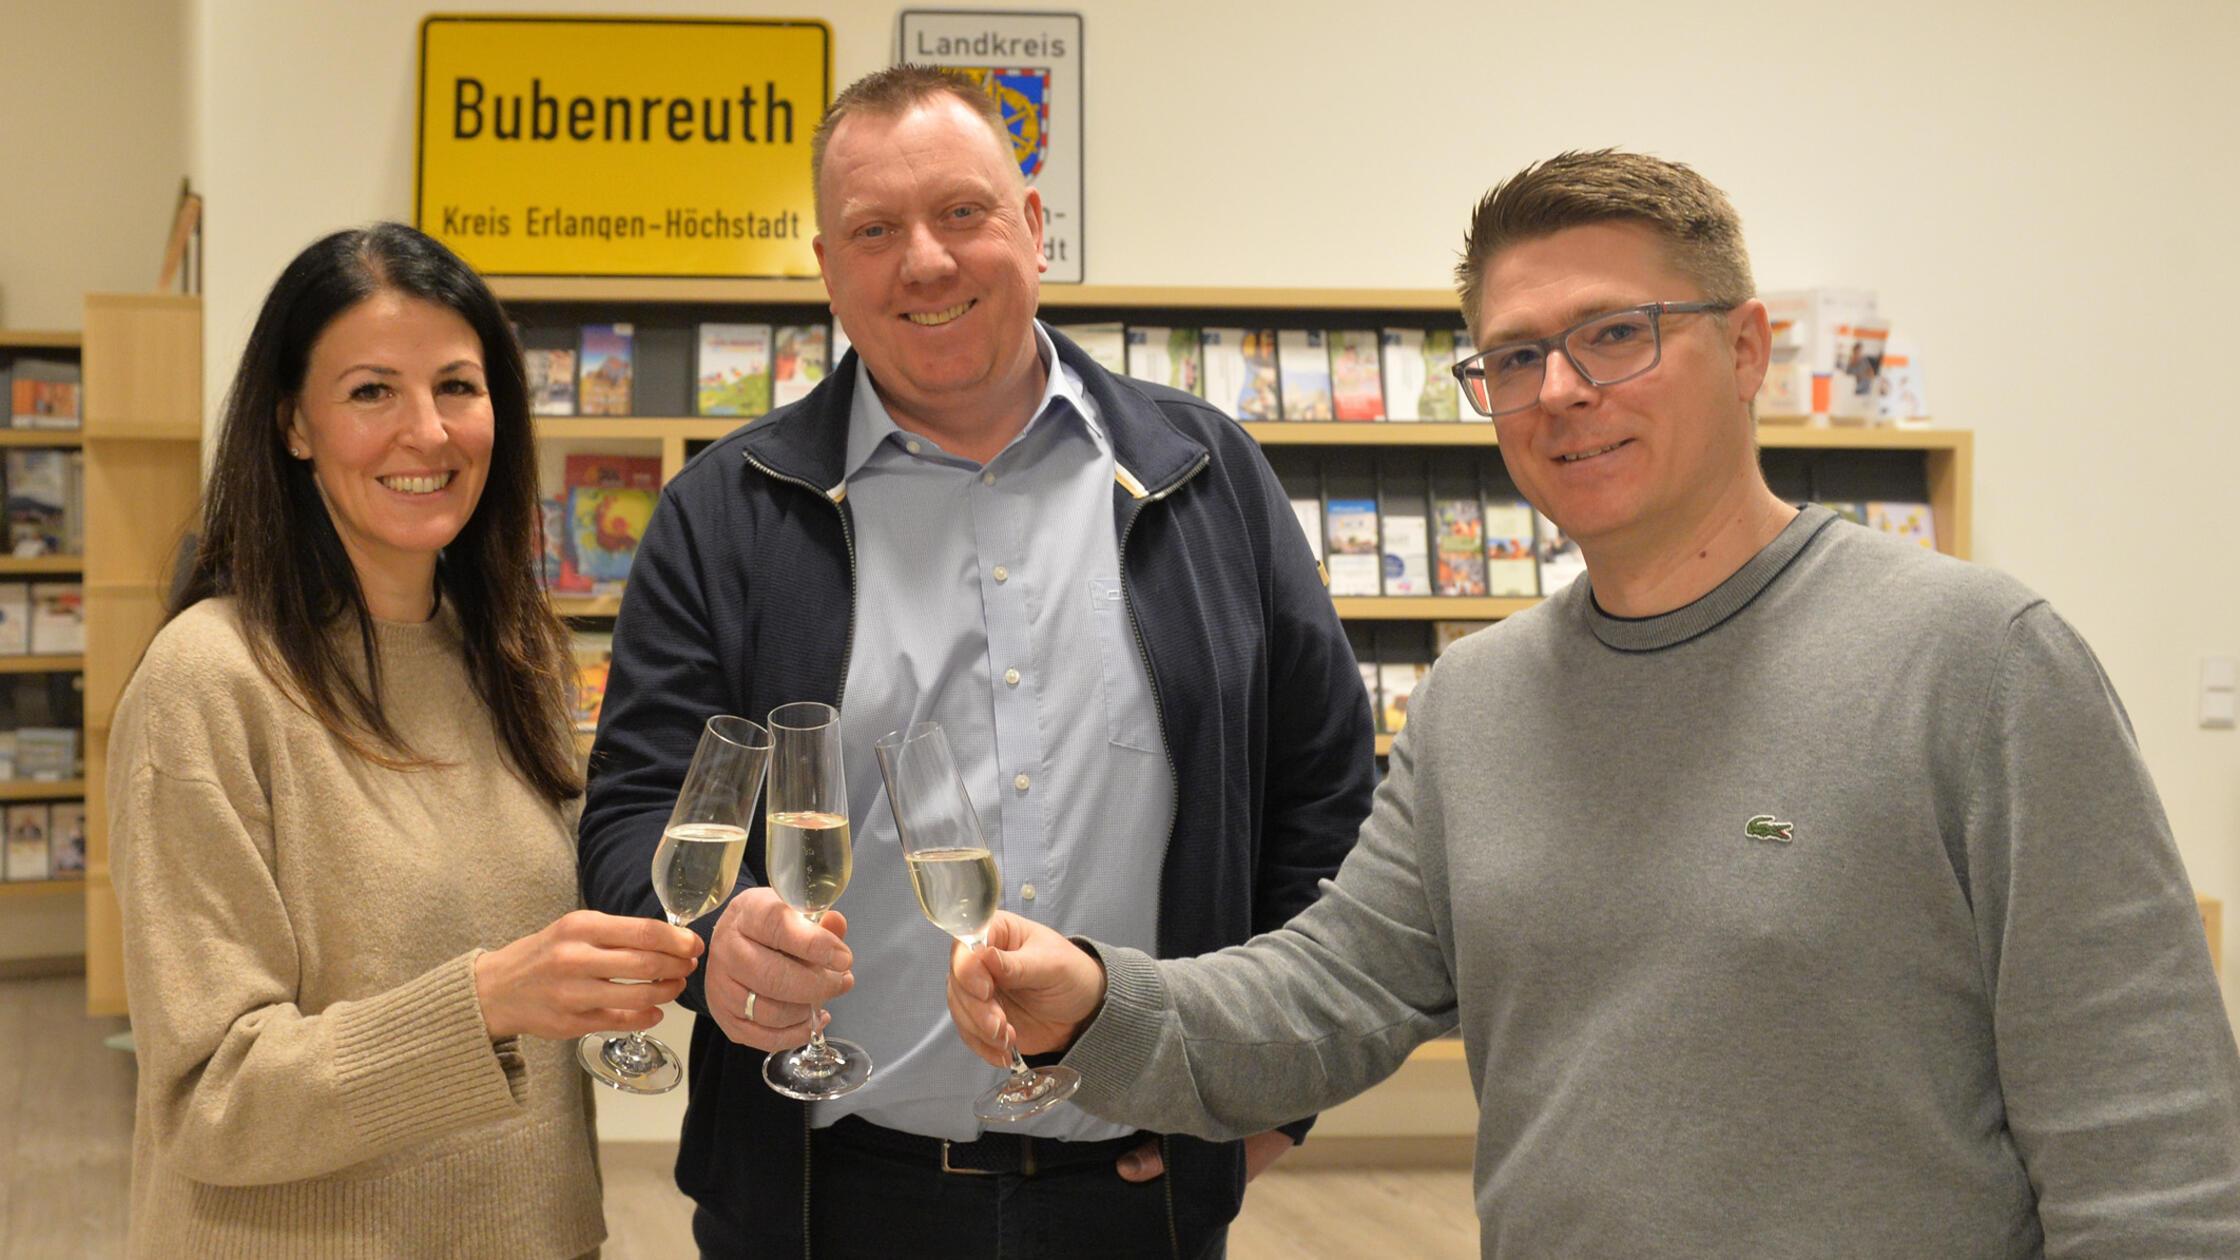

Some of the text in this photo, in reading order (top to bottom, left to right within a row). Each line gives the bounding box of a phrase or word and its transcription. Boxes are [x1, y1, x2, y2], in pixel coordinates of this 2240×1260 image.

[917, 31, 1066, 58] Landkreis
[454, 77, 795, 144] Bubenreuth
[443, 205, 801, 241] Kreis Erlangen-Höchstadt
